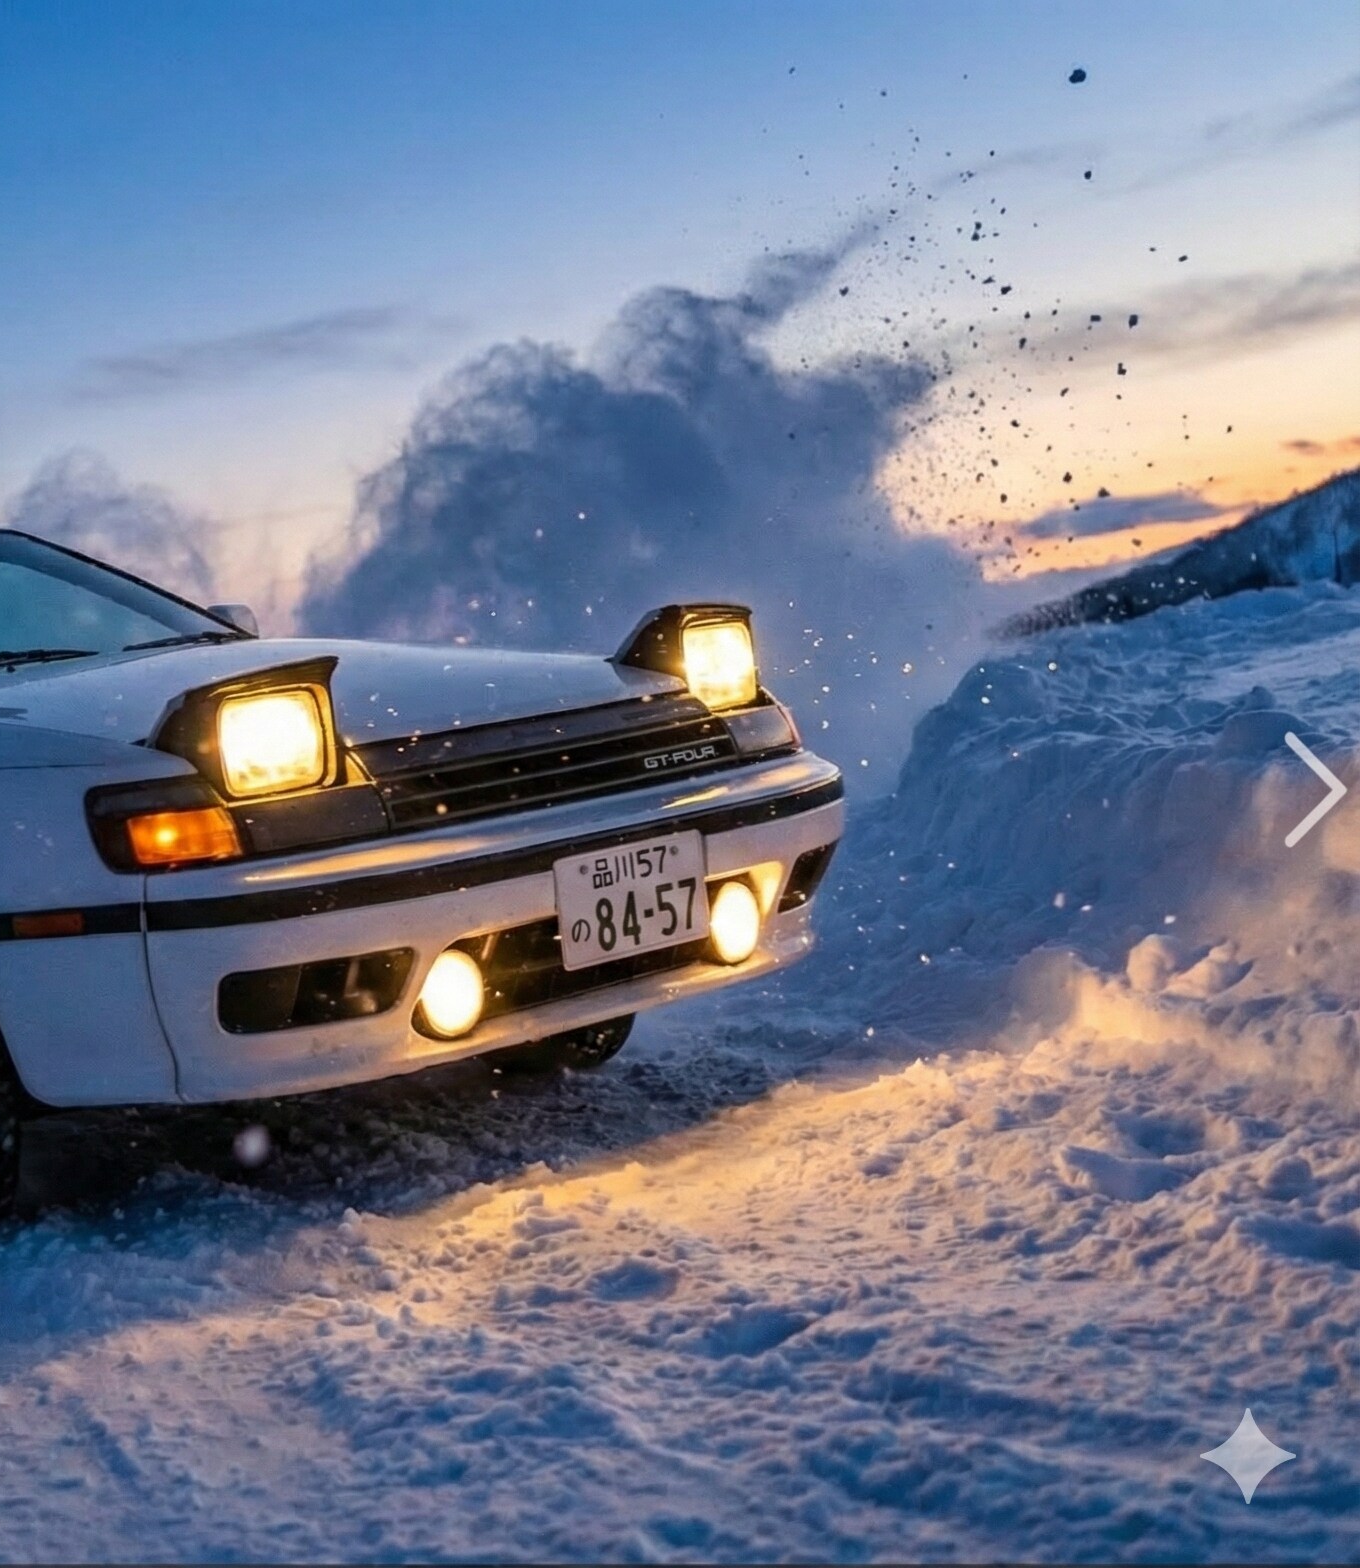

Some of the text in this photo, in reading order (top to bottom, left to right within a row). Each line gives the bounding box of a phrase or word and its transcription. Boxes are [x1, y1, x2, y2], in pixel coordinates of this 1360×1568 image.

[644, 746, 717, 769] GT-FOUR
[572, 877, 697, 951] の 84-57
